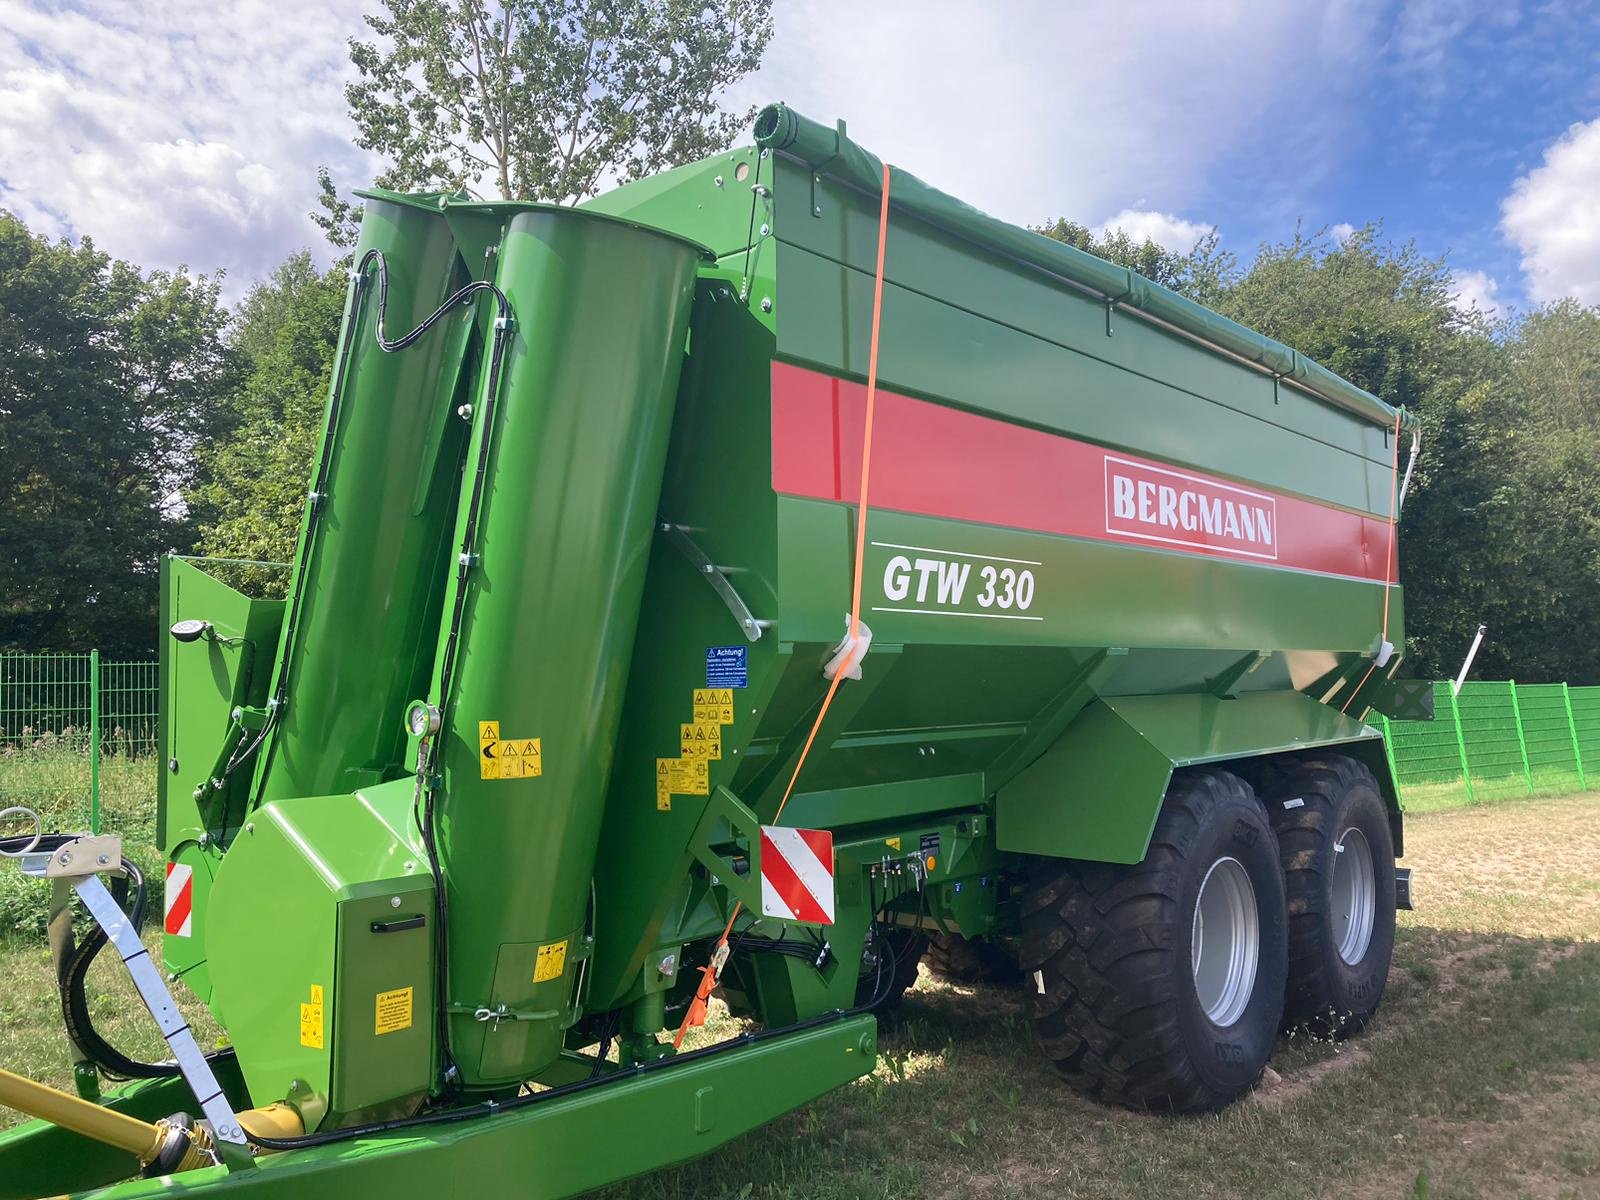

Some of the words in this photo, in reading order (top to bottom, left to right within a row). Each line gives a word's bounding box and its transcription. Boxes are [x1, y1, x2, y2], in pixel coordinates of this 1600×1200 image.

[1112, 474, 1273, 546] BERGMANN
[883, 555, 971, 606] GTW
[976, 565, 1035, 611] 330
